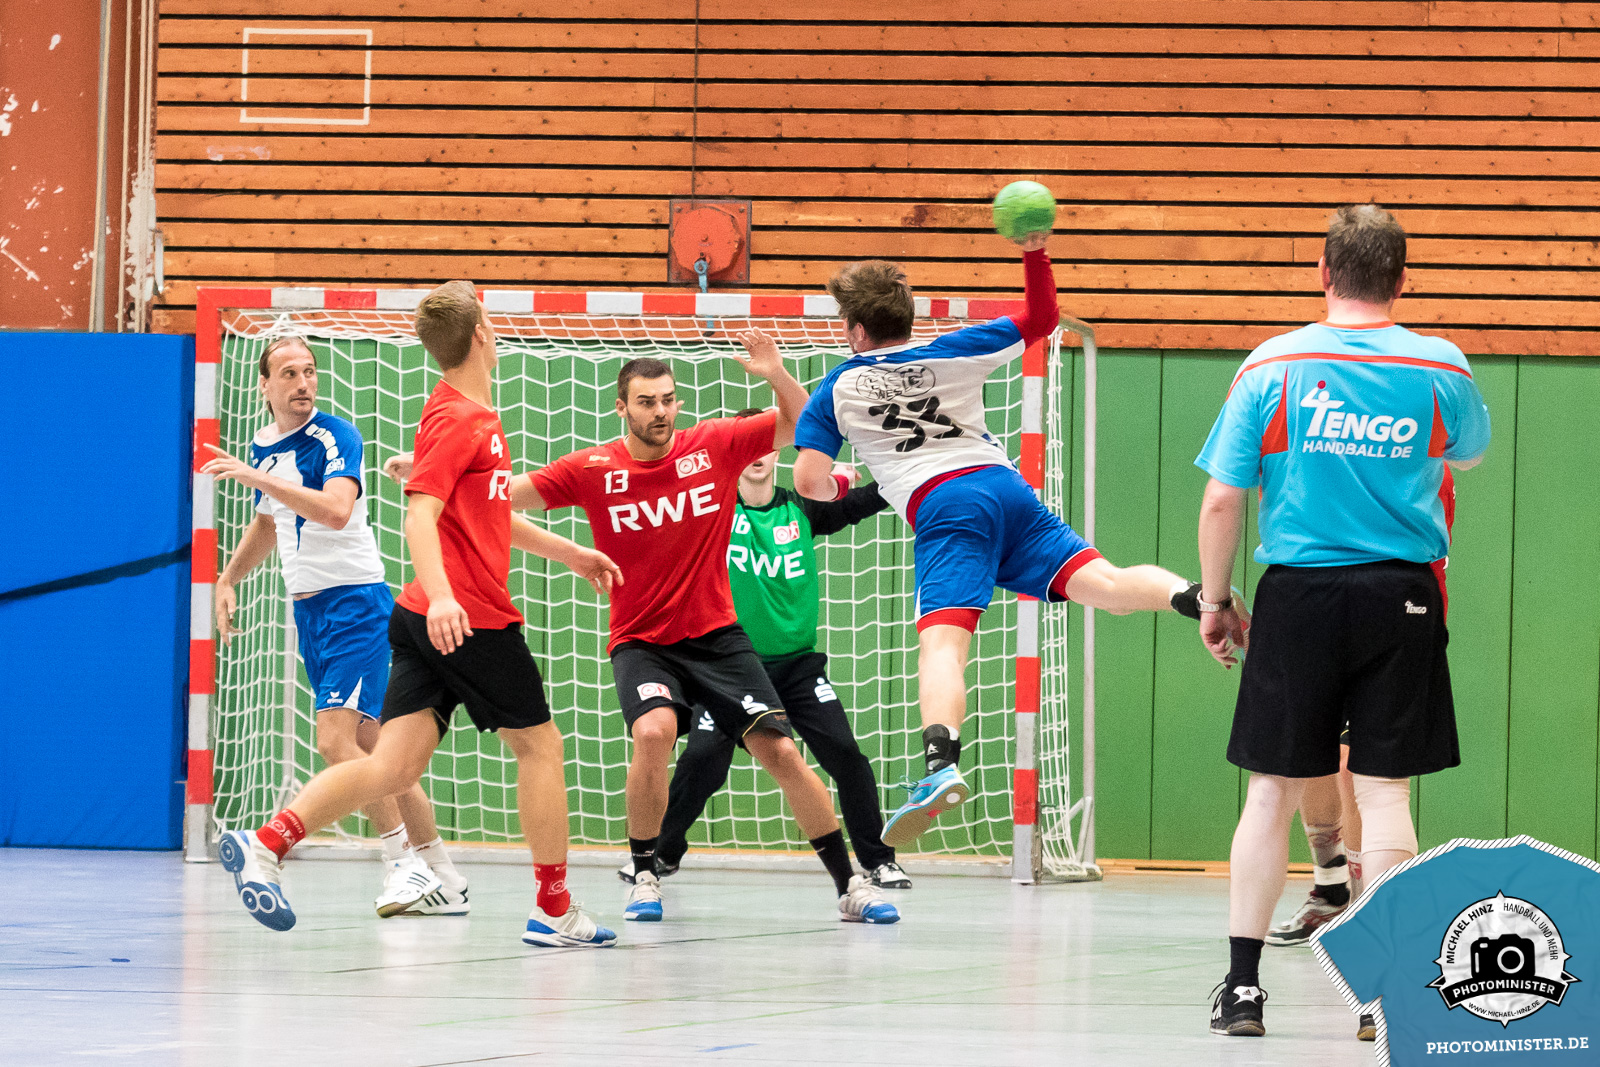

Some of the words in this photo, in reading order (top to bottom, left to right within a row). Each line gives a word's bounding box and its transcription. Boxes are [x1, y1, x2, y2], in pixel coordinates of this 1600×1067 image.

[868, 396, 964, 453] 33
[1300, 388, 1418, 444] TENGO
[490, 433, 504, 459] 4
[1302, 440, 1413, 459] HANDBALL.DE
[604, 469, 629, 495] 13
[608, 482, 721, 533] RWE
[726, 544, 805, 580] RWE
